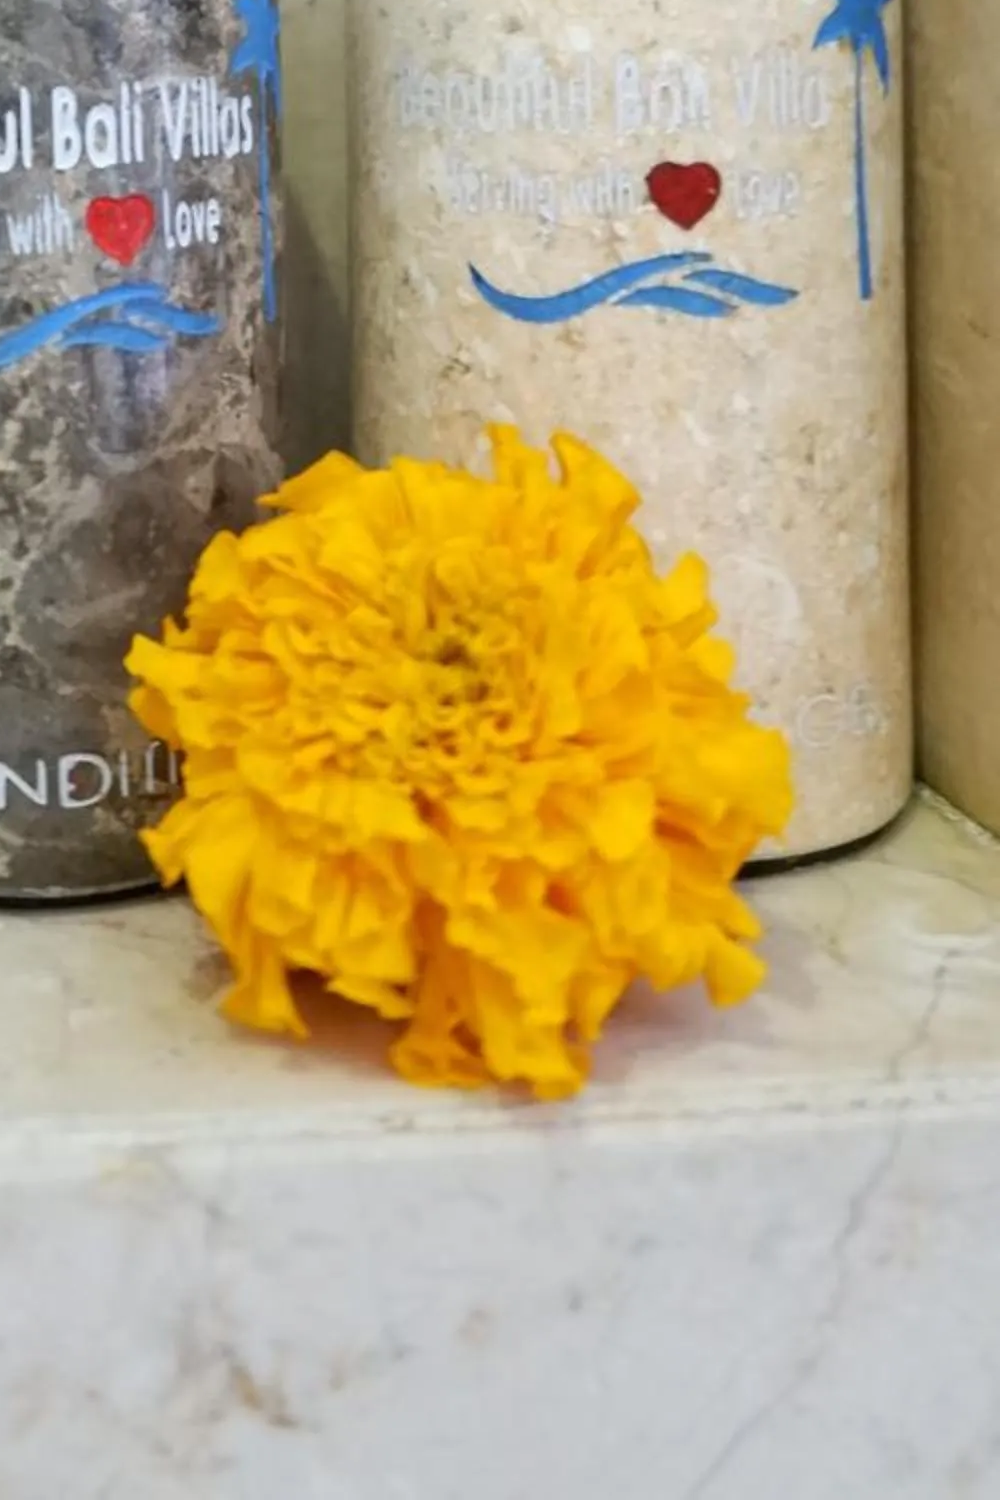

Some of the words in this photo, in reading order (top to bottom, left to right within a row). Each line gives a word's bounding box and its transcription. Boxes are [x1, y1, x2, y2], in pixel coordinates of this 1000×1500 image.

[50, 79, 145, 172] Bali
[158, 75, 255, 162] Villas
[6, 192, 74, 256] with
